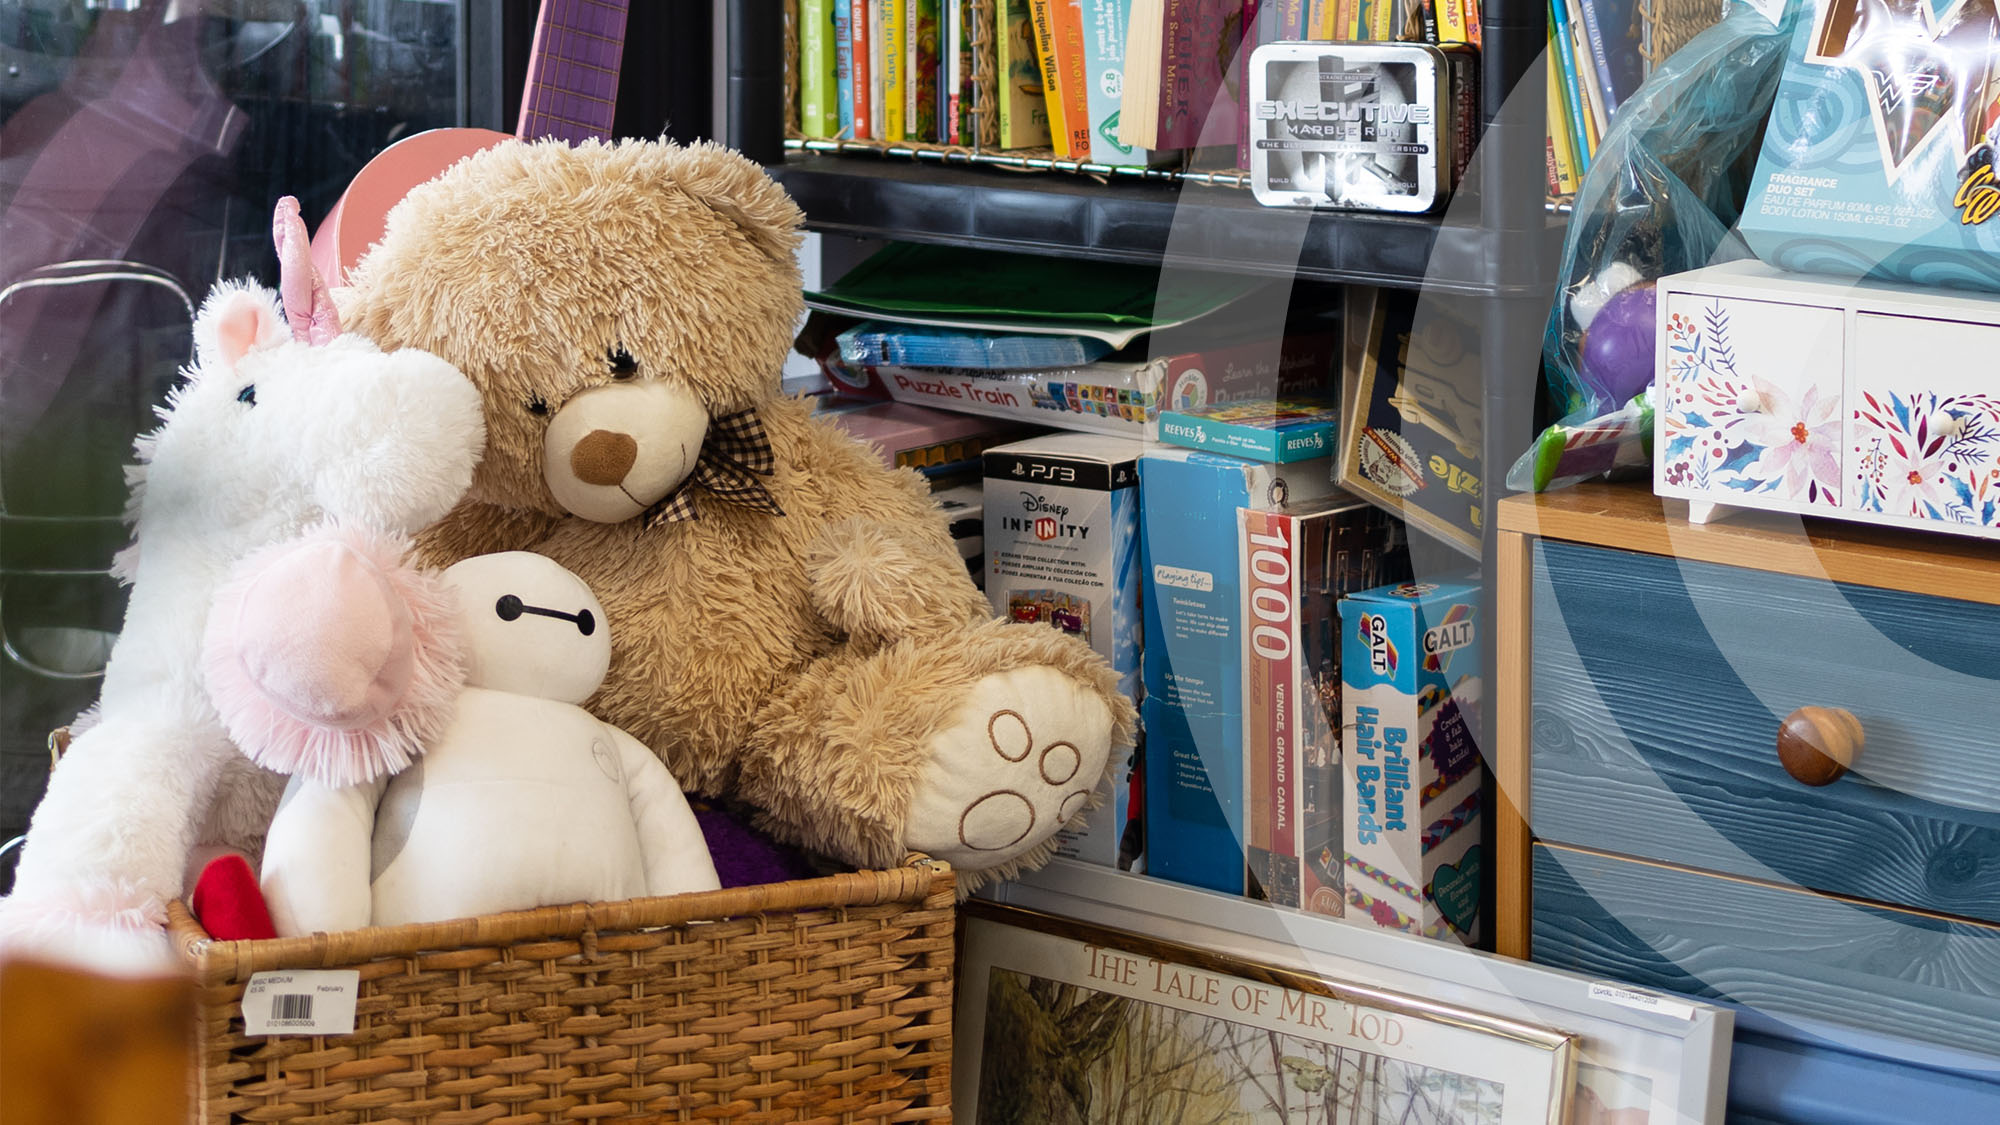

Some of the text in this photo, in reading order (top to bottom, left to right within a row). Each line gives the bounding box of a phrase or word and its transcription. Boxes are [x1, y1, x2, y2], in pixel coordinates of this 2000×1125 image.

[1096, 12, 1105, 26] to
[1097, 28, 1106, 55] want
[1105, 2, 1120, 62] job puzzles
[1168, 21, 1179, 60] Secret
[838, 17, 850, 80] Phil Earle
[1035, 1, 1057, 92] Jacqueline Wilson
[1593, 35, 1607, 67] Witch
[1165, 64, 1176, 108] Mirror
[1255, 100, 1430, 124] EXECUTIVE
[1286, 125, 1401, 138] MARBLE RUN
[1546, 145, 1559, 185] Ladybird
[1767, 184, 1816, 197] DUO SET
[1769, 173, 1839, 189] FRAGRANCE
[1760, 205, 1789, 217] BODY
[1791, 207, 1830, 221] LOTION
[1763, 194, 1785, 205] EAU
[1786, 196, 1802, 206] DE
[1801, 198, 1846, 212] PARFUM
[894, 375, 1019, 408] Puzzle Train
[1164, 423, 1196, 439] REEVES
[1287, 438, 1314, 450] REEVES
[1031, 464, 1076, 482] PS3
[1429, 455, 1481, 497] zle
[1003, 516, 1090, 540] INFINITY
[1156, 569, 1189, 586] Playing
[1250, 525, 1291, 662] 1000
[1164, 673, 1174, 681] Up
[1174, 674, 1184, 682] the
[1173, 750, 1190, 759] Great
[1275, 682, 1286, 831] VENICE, GRAND CANAL
[1356, 705, 1383, 846] Hair Bands
[1383, 726, 1411, 831] Brilliant
[268, 975, 293, 984] MEDIUM
[316, 984, 344, 993] February
[1083, 944, 1405, 1047] THE TALE OF MR. TOD
